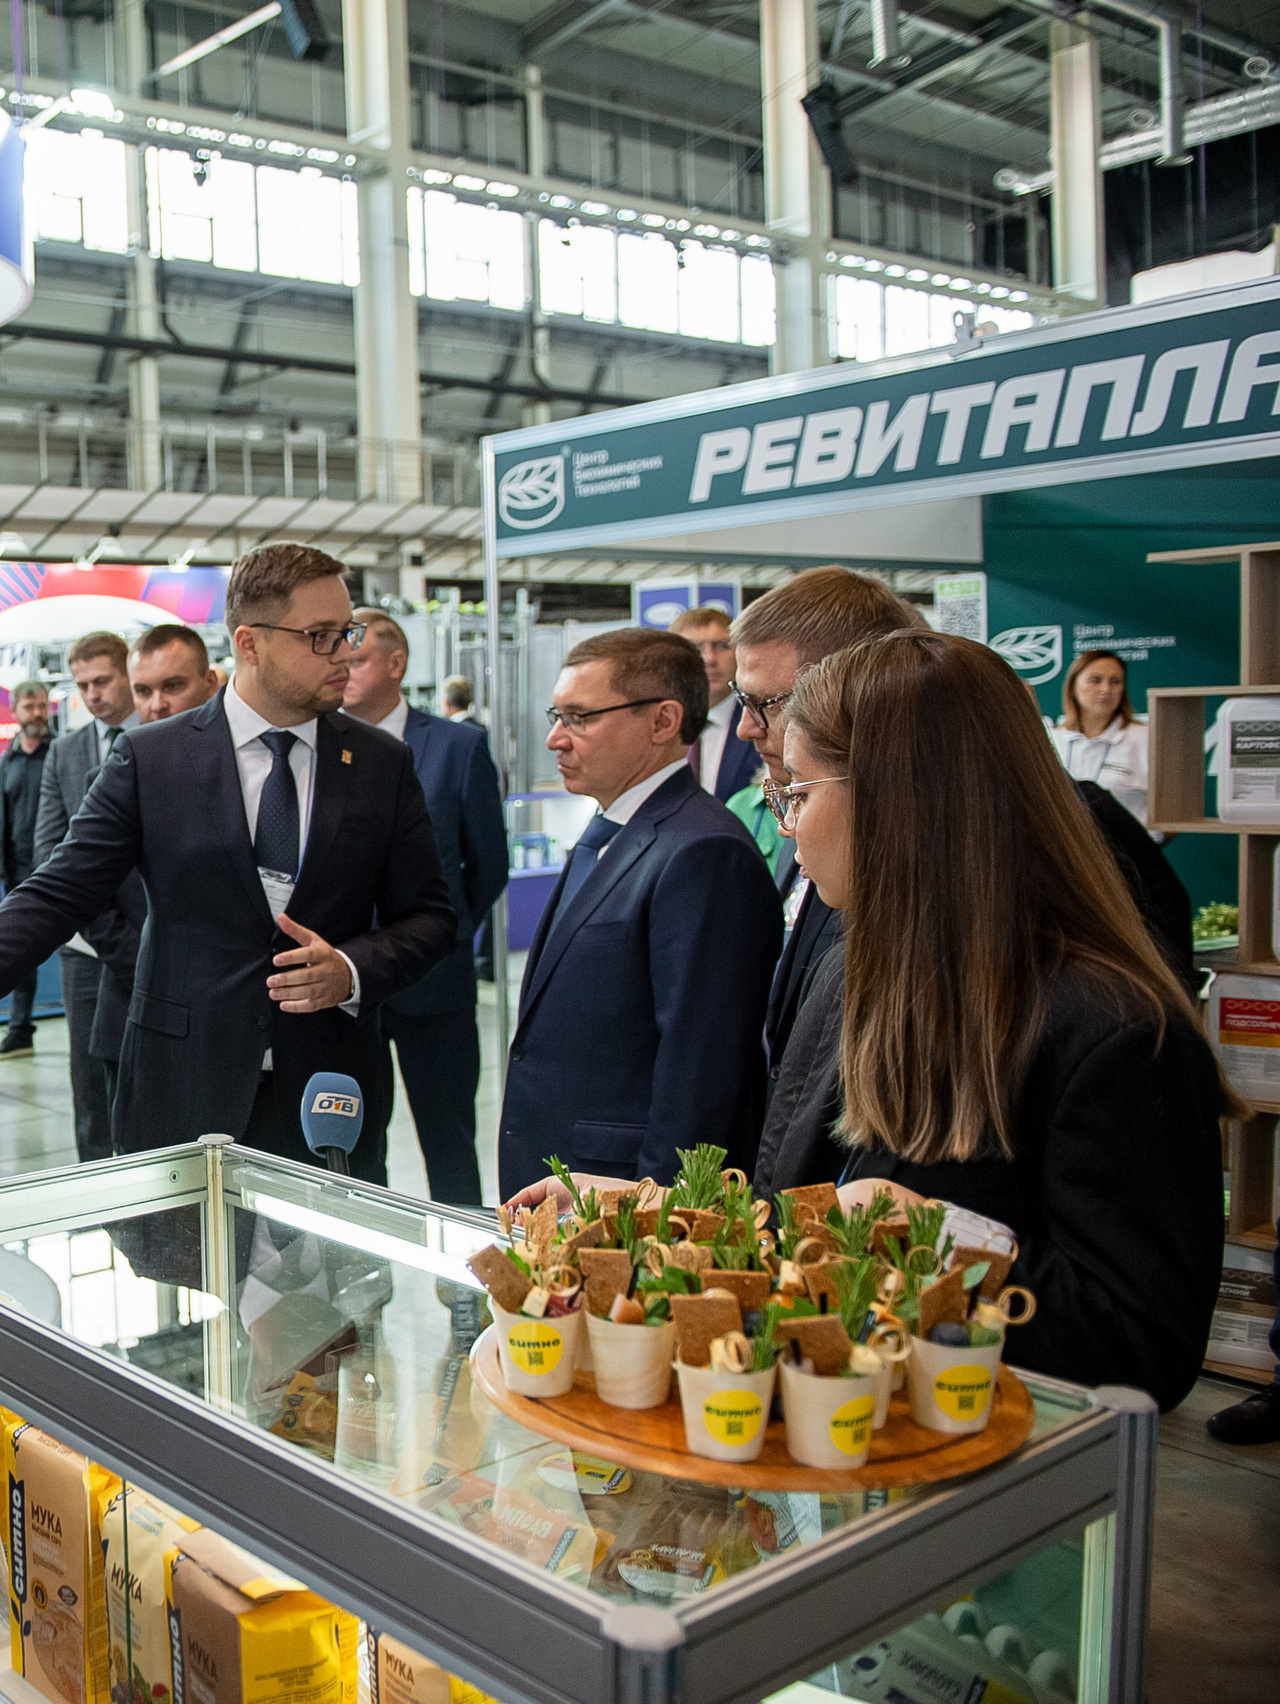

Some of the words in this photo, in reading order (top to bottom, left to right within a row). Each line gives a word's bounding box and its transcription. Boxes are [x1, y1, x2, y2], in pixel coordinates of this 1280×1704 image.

[690, 330, 1280, 503] РЕВИТАПЛА
[508, 1337, 561, 1351] ситно
[31, 1501, 62, 1538] МУКА
[13, 1488, 24, 1595] ситно
[385, 1649, 415, 1685] МУКА
